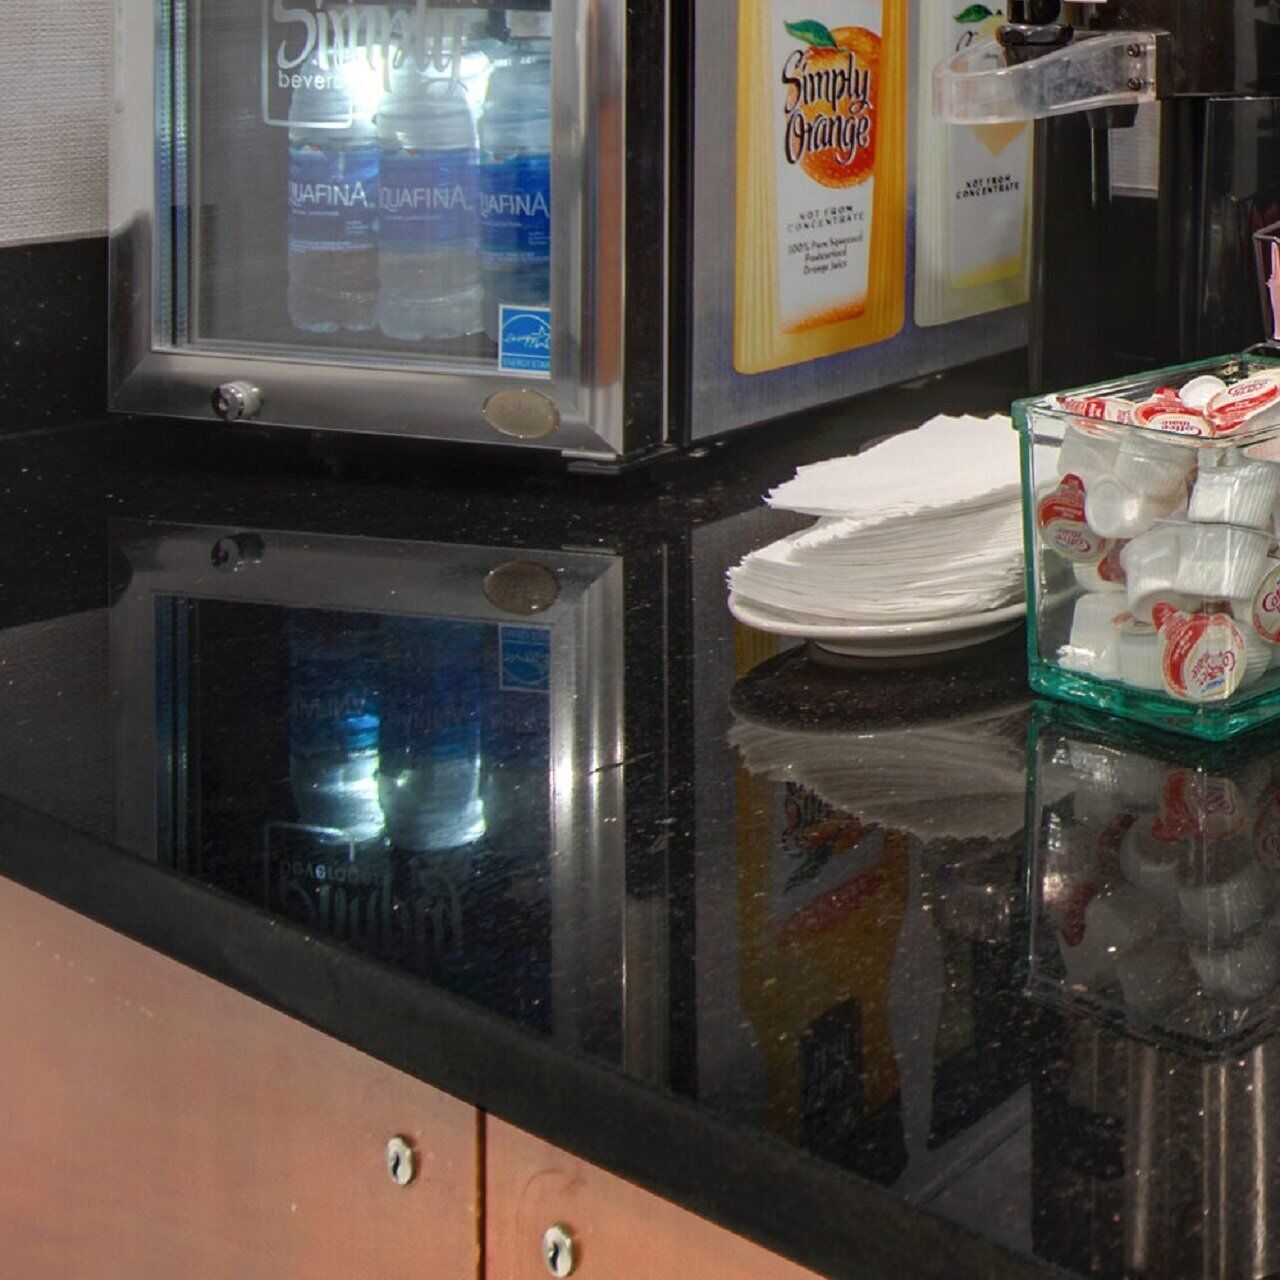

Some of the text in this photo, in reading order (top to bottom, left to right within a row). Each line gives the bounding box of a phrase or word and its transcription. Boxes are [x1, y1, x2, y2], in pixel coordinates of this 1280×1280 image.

[782, 49, 874, 114] Simply
[785, 111, 870, 165] Orange
[956, 182, 1020, 200] CONCENTRATE
[966, 174, 1012, 190] NOT FROM
[787, 211, 864, 233] CONCENTRATE
[799, 205, 853, 221] NOT FROM
